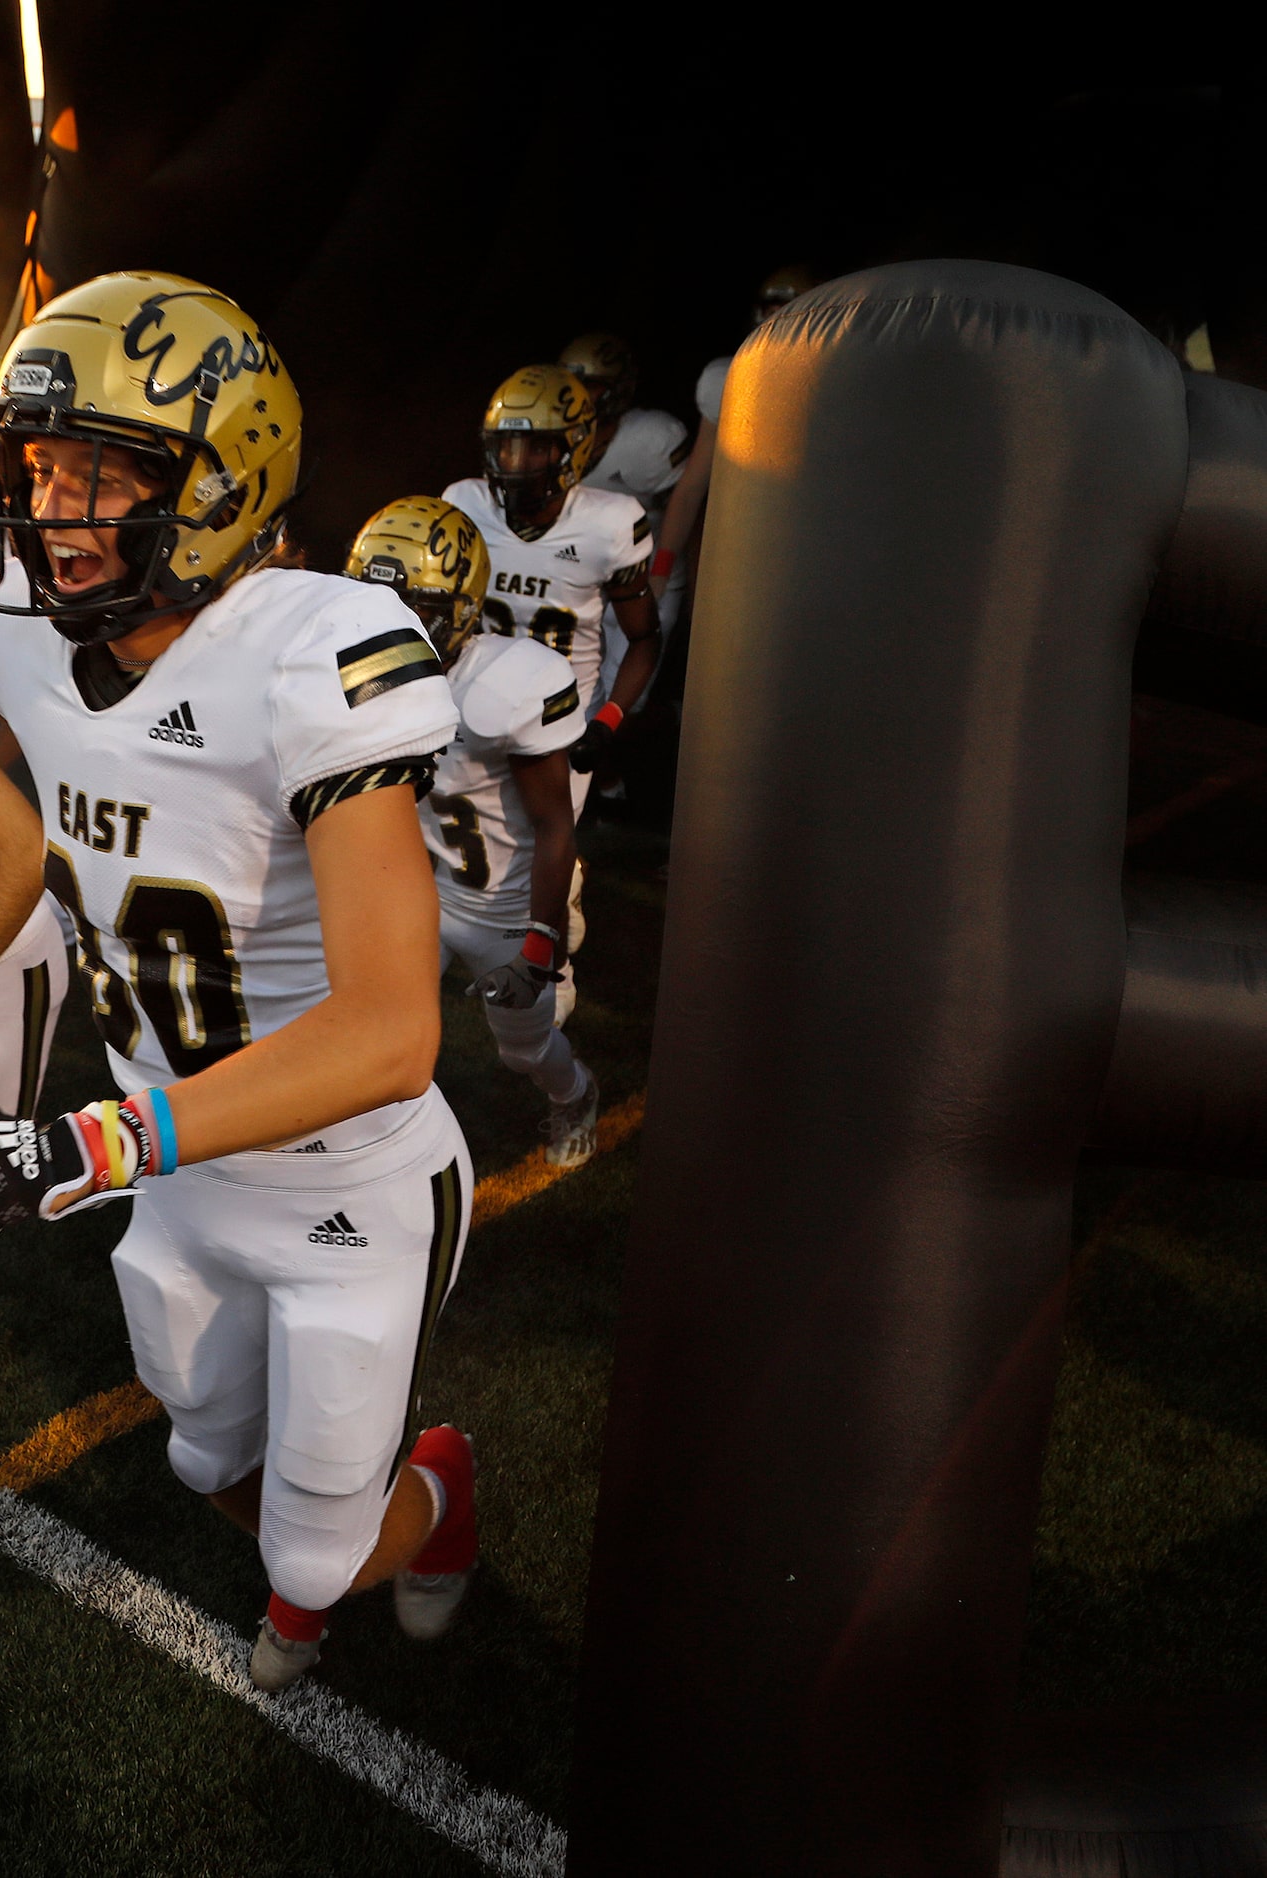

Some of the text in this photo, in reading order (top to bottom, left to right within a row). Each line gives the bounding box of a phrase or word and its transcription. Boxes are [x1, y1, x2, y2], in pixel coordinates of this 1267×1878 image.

[124, 293, 279, 407] East
[372, 566, 394, 579] PESH
[495, 571, 552, 599] EAST
[147, 726, 205, 749] adidas
[58, 780, 153, 858] EAST
[307, 1231, 369, 1248] adidas
